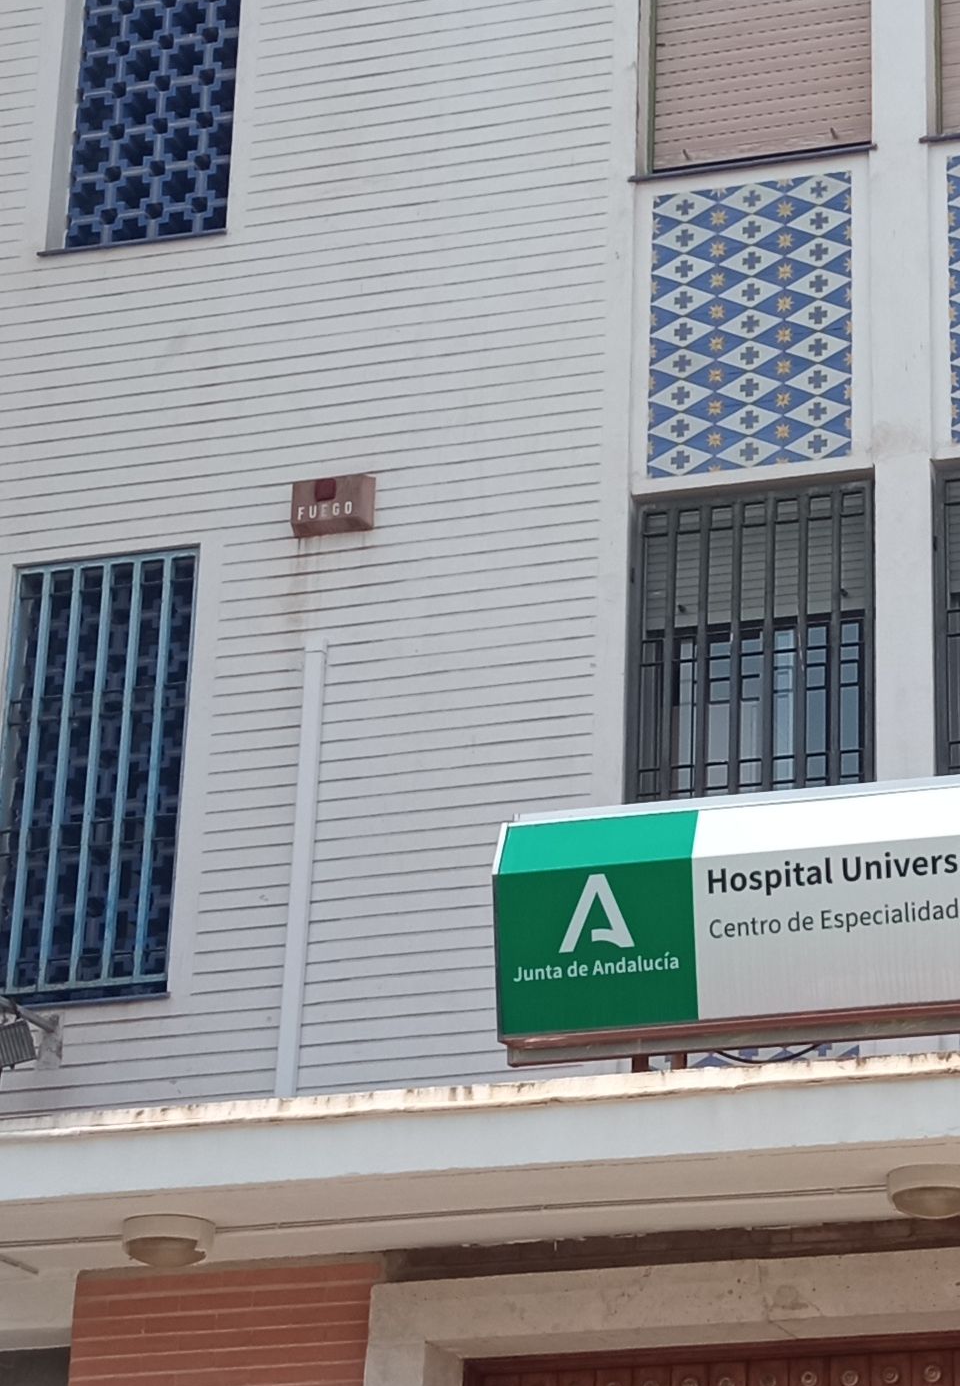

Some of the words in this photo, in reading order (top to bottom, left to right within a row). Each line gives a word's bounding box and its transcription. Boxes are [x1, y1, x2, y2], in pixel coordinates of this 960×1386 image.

[297, 501, 352, 520] FUEGO
[708, 857, 832, 896] Hospital
[709, 917, 781, 939] Centro
[787, 911, 814, 933] de
[513, 965, 562, 982] Junta
[567, 960, 588, 977] de
[593, 951, 679, 975] Andalucía
